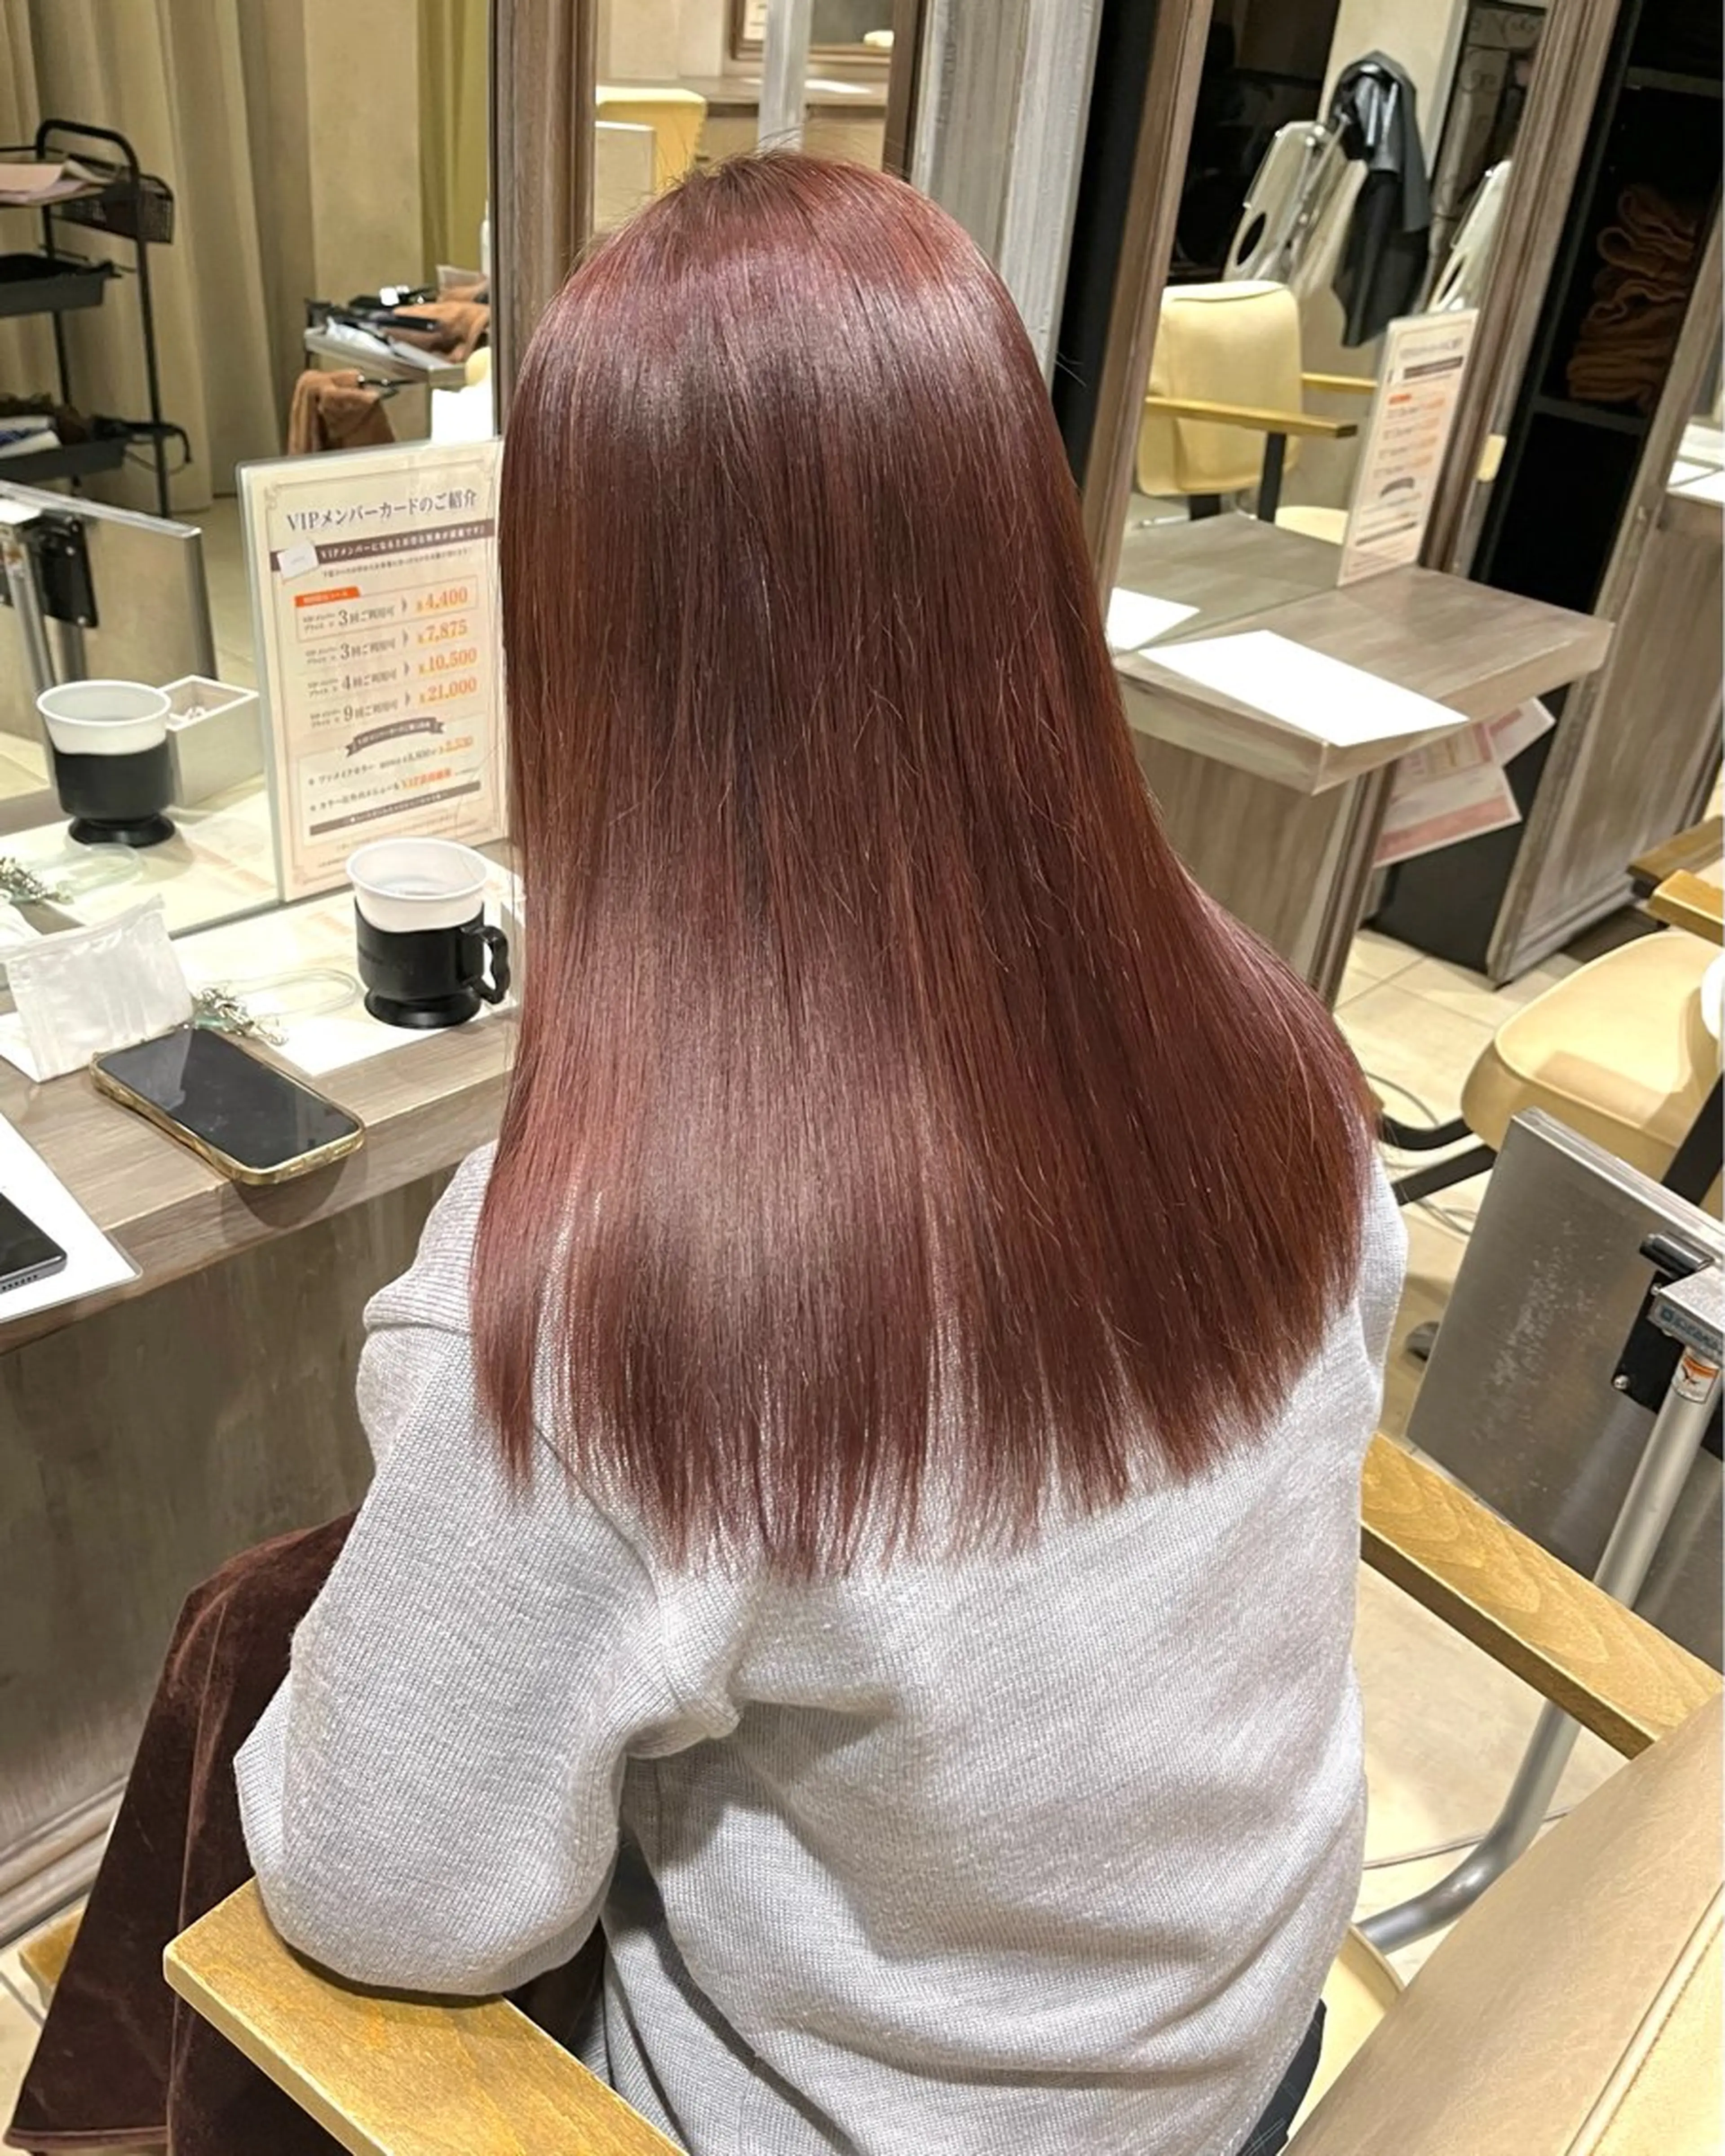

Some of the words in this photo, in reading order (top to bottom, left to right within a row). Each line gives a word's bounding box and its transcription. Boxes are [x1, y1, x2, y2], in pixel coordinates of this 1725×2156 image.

[287, 489, 477, 531] VIPメンバーカードのご紹介
